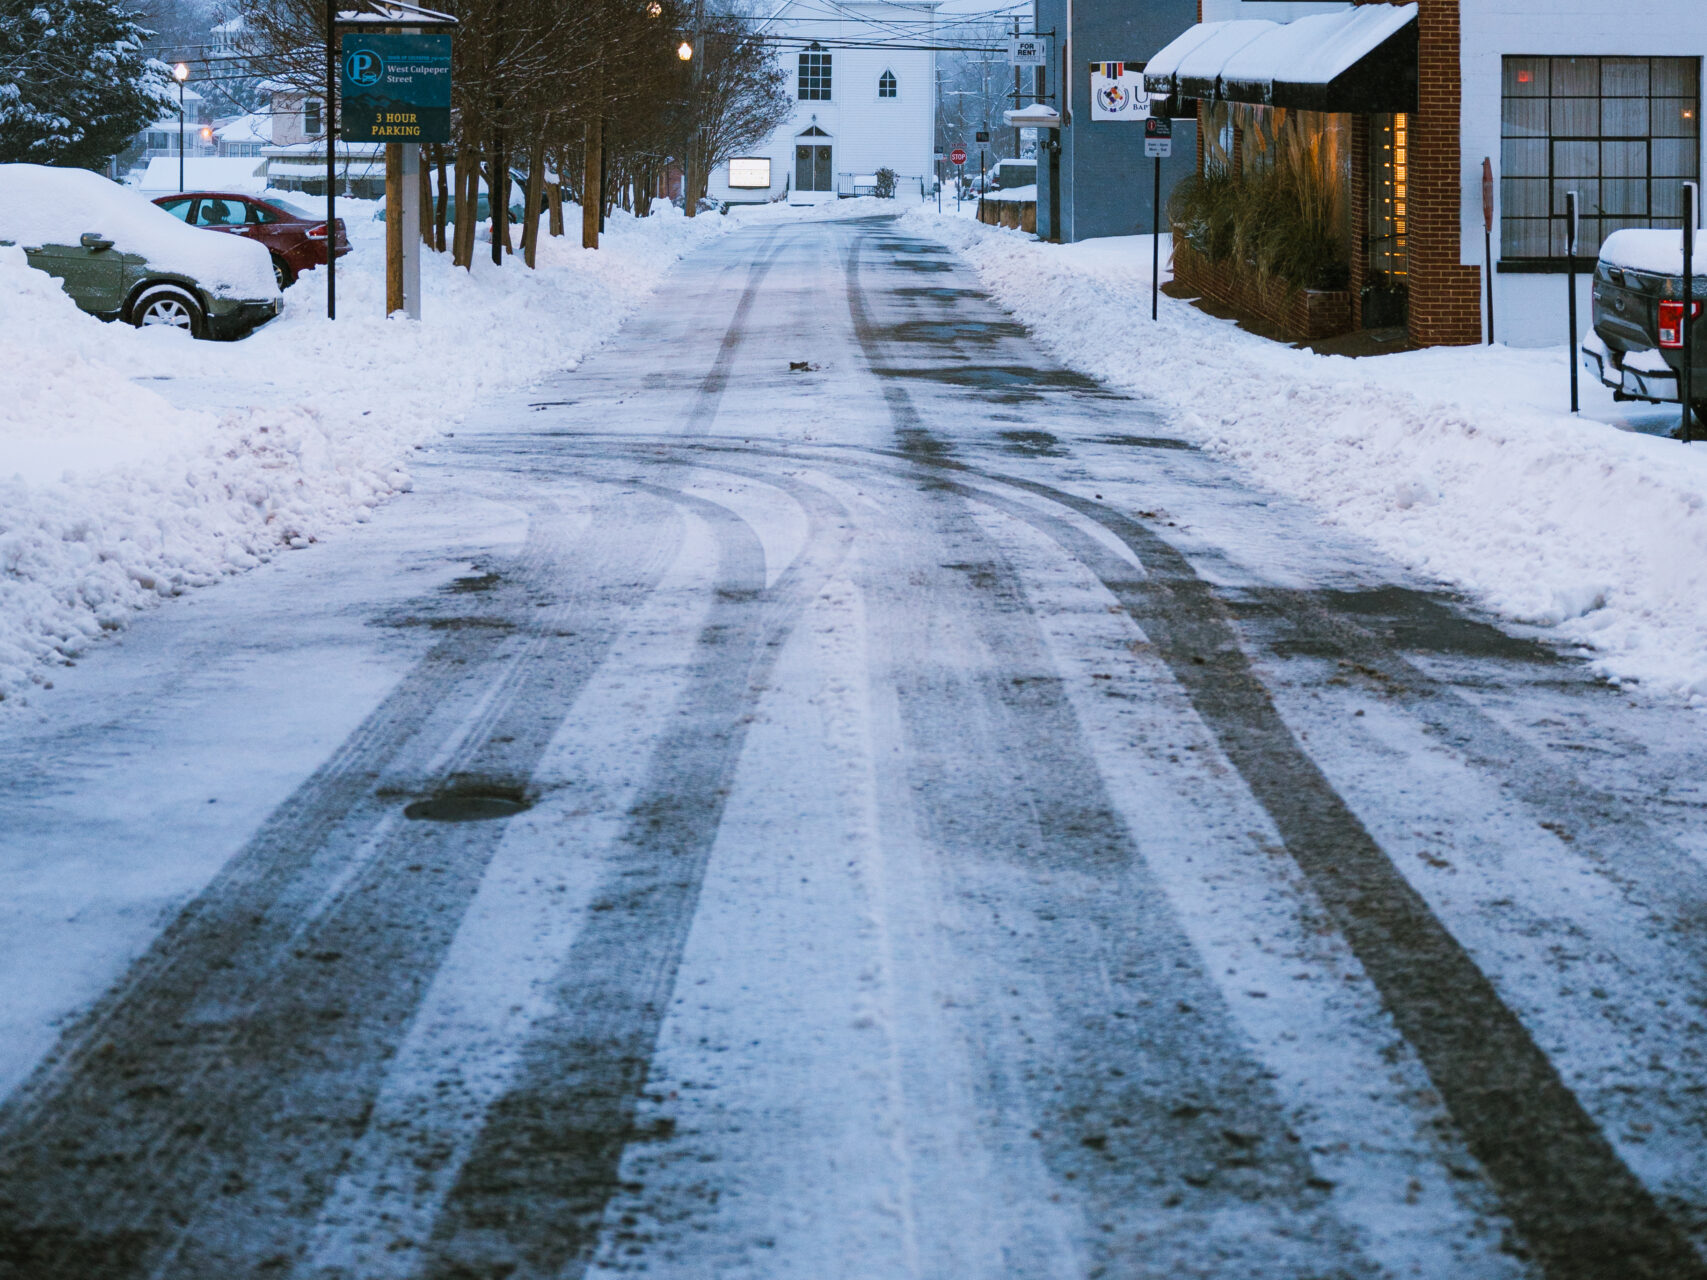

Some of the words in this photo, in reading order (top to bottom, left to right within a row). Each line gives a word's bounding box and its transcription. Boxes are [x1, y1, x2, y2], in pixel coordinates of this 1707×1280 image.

[387, 65, 408, 73] West
[410, 65, 449, 75] Culpeper
[386, 75, 413, 83] Street
[1133, 103, 1150, 111] BAP
[376, 113, 382, 123] 3
[386, 113, 417, 123] HOUR
[371, 125, 420, 136] PARKING
[951, 153, 966, 161] STOP
